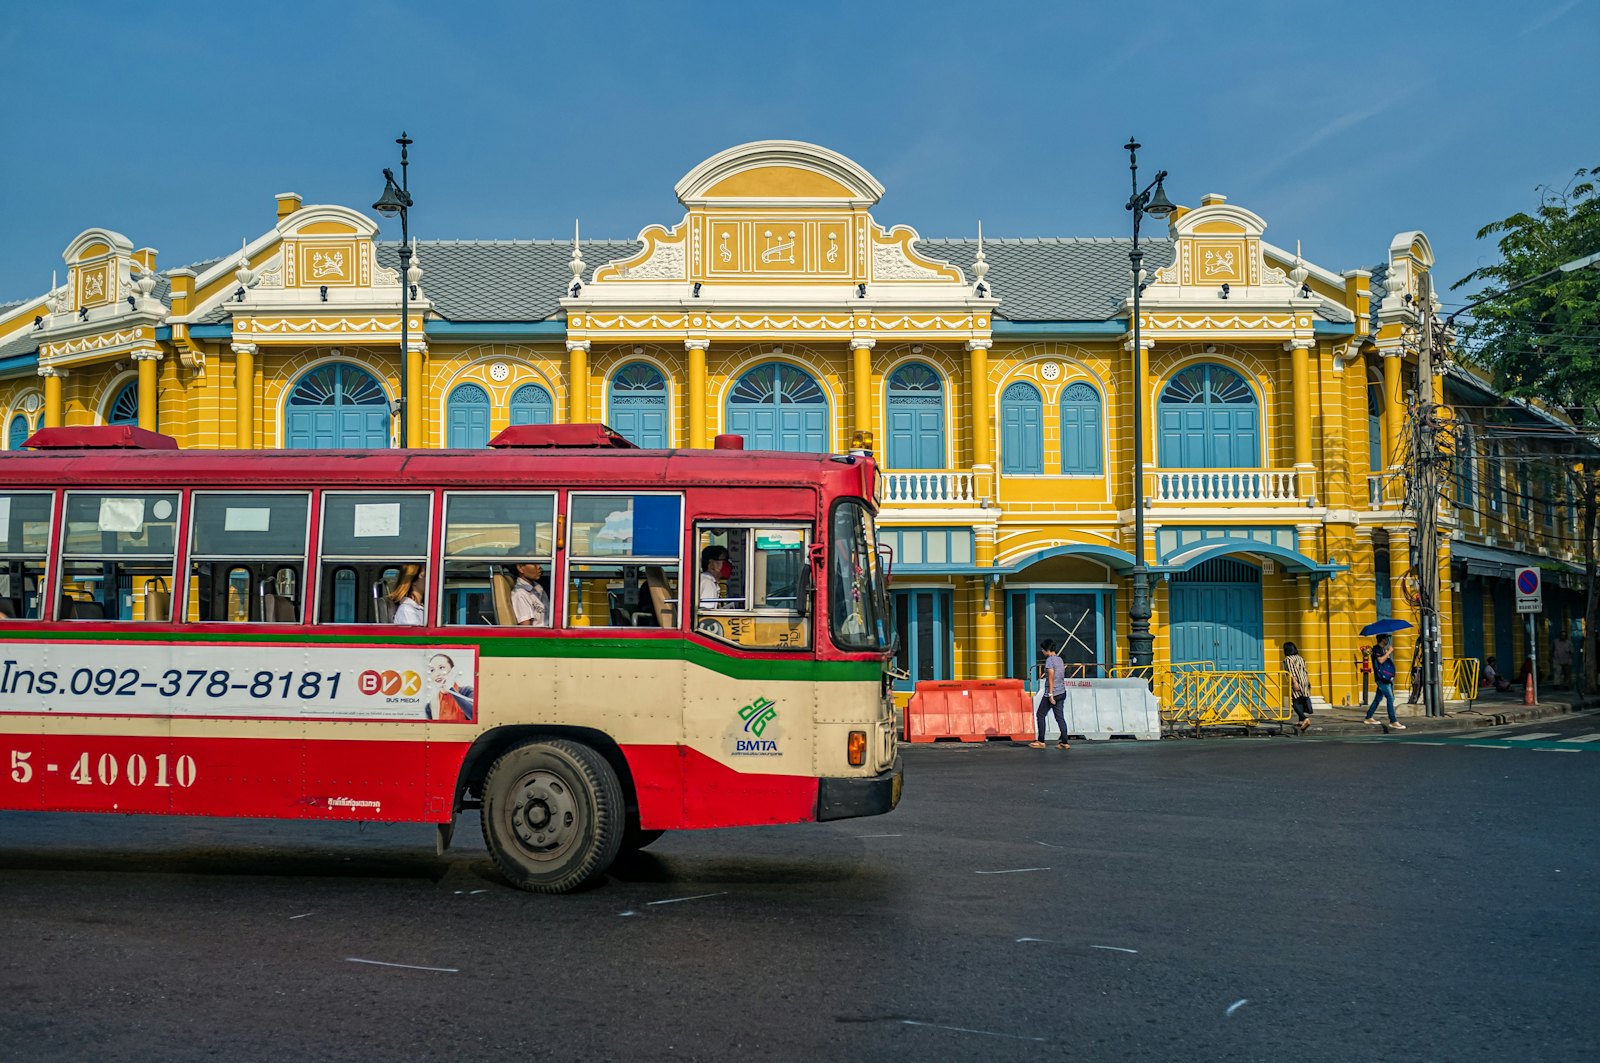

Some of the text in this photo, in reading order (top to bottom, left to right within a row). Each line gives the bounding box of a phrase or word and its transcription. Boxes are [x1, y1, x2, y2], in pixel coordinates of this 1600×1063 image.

[1, 660, 341, 700] โทร.092-378-8181
[361, 673, 420, 693] BVK
[736, 740, 777, 751] BMTA
[11, 750, 33, 783] 5
[70, 752, 197, 788] 40010
